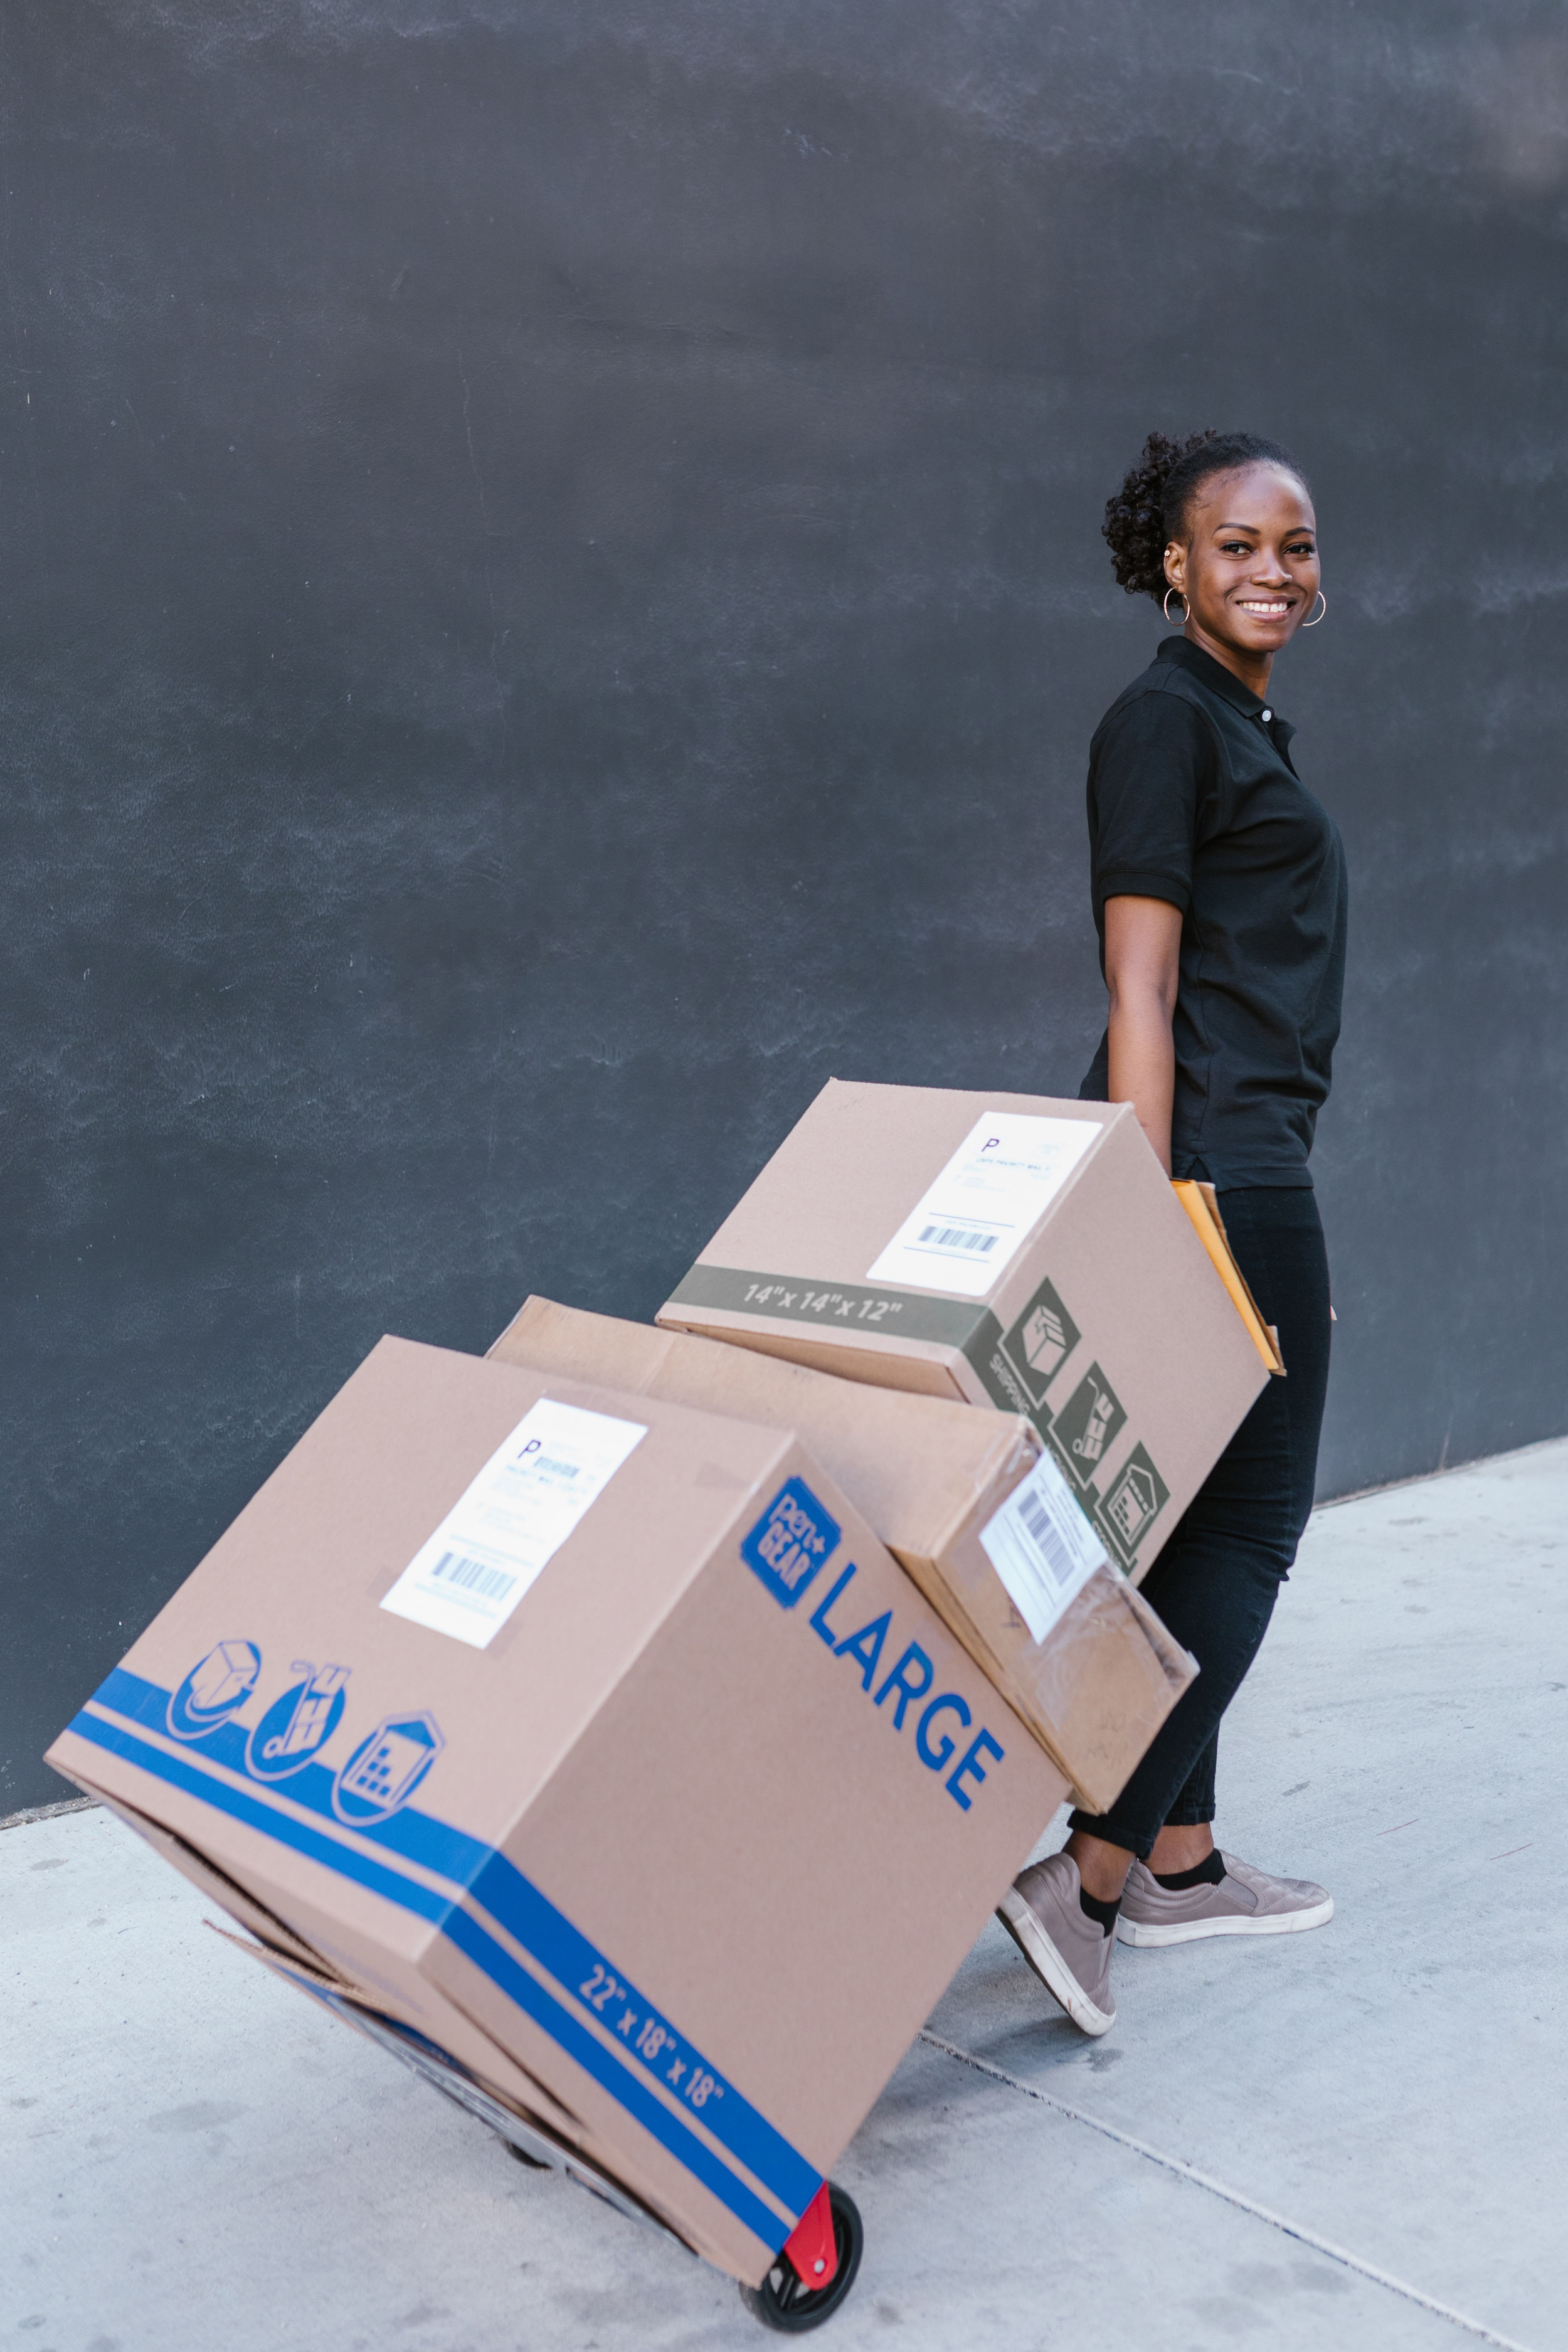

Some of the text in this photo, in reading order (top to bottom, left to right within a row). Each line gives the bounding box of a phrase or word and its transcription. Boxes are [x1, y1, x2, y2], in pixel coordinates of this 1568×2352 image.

[980, 1138, 1000, 1152] P
[857, 1299, 903, 1322] 12"
[989, 1353, 1031, 1416] SHIPPING
[516, 1439, 541, 1459] P
[757, 1520, 811, 1592] GEAR
[809, 1561, 1005, 1813] LARGE
[579, 1963, 725, 2109] 22" x 18" x 18"
